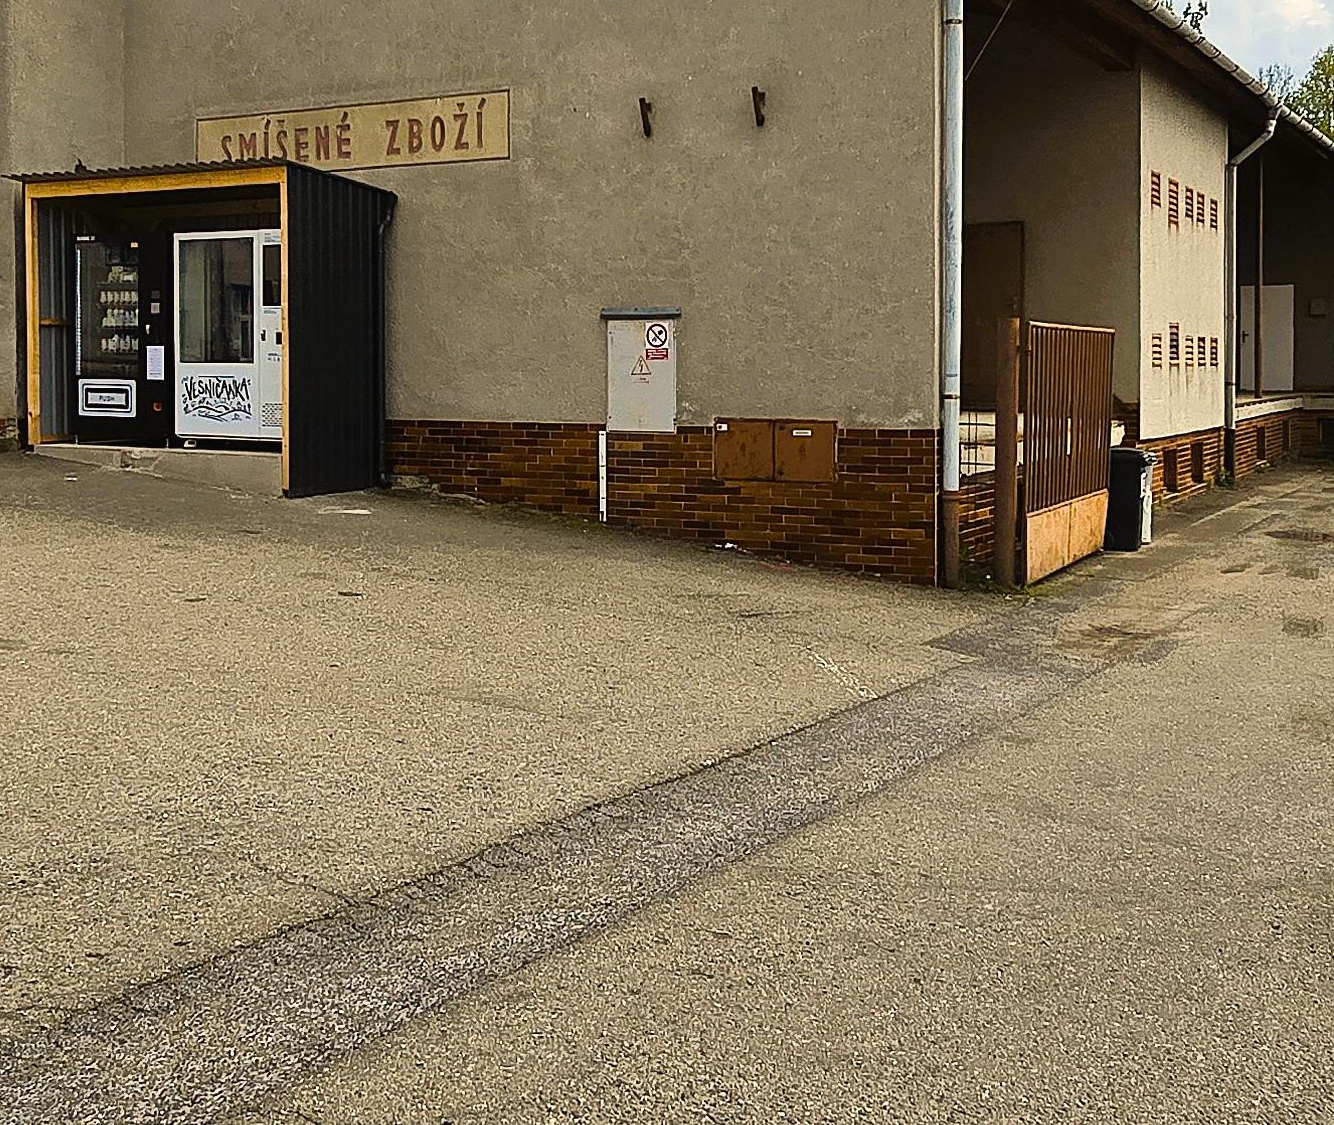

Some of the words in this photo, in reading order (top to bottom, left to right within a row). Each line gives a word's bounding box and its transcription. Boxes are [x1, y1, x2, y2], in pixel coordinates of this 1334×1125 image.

[221, 111, 352, 162] SMÍŠENÉ
[385, 97, 487, 157] ZBOŽÍ
[184, 375, 250, 402] VESNIČANKA
